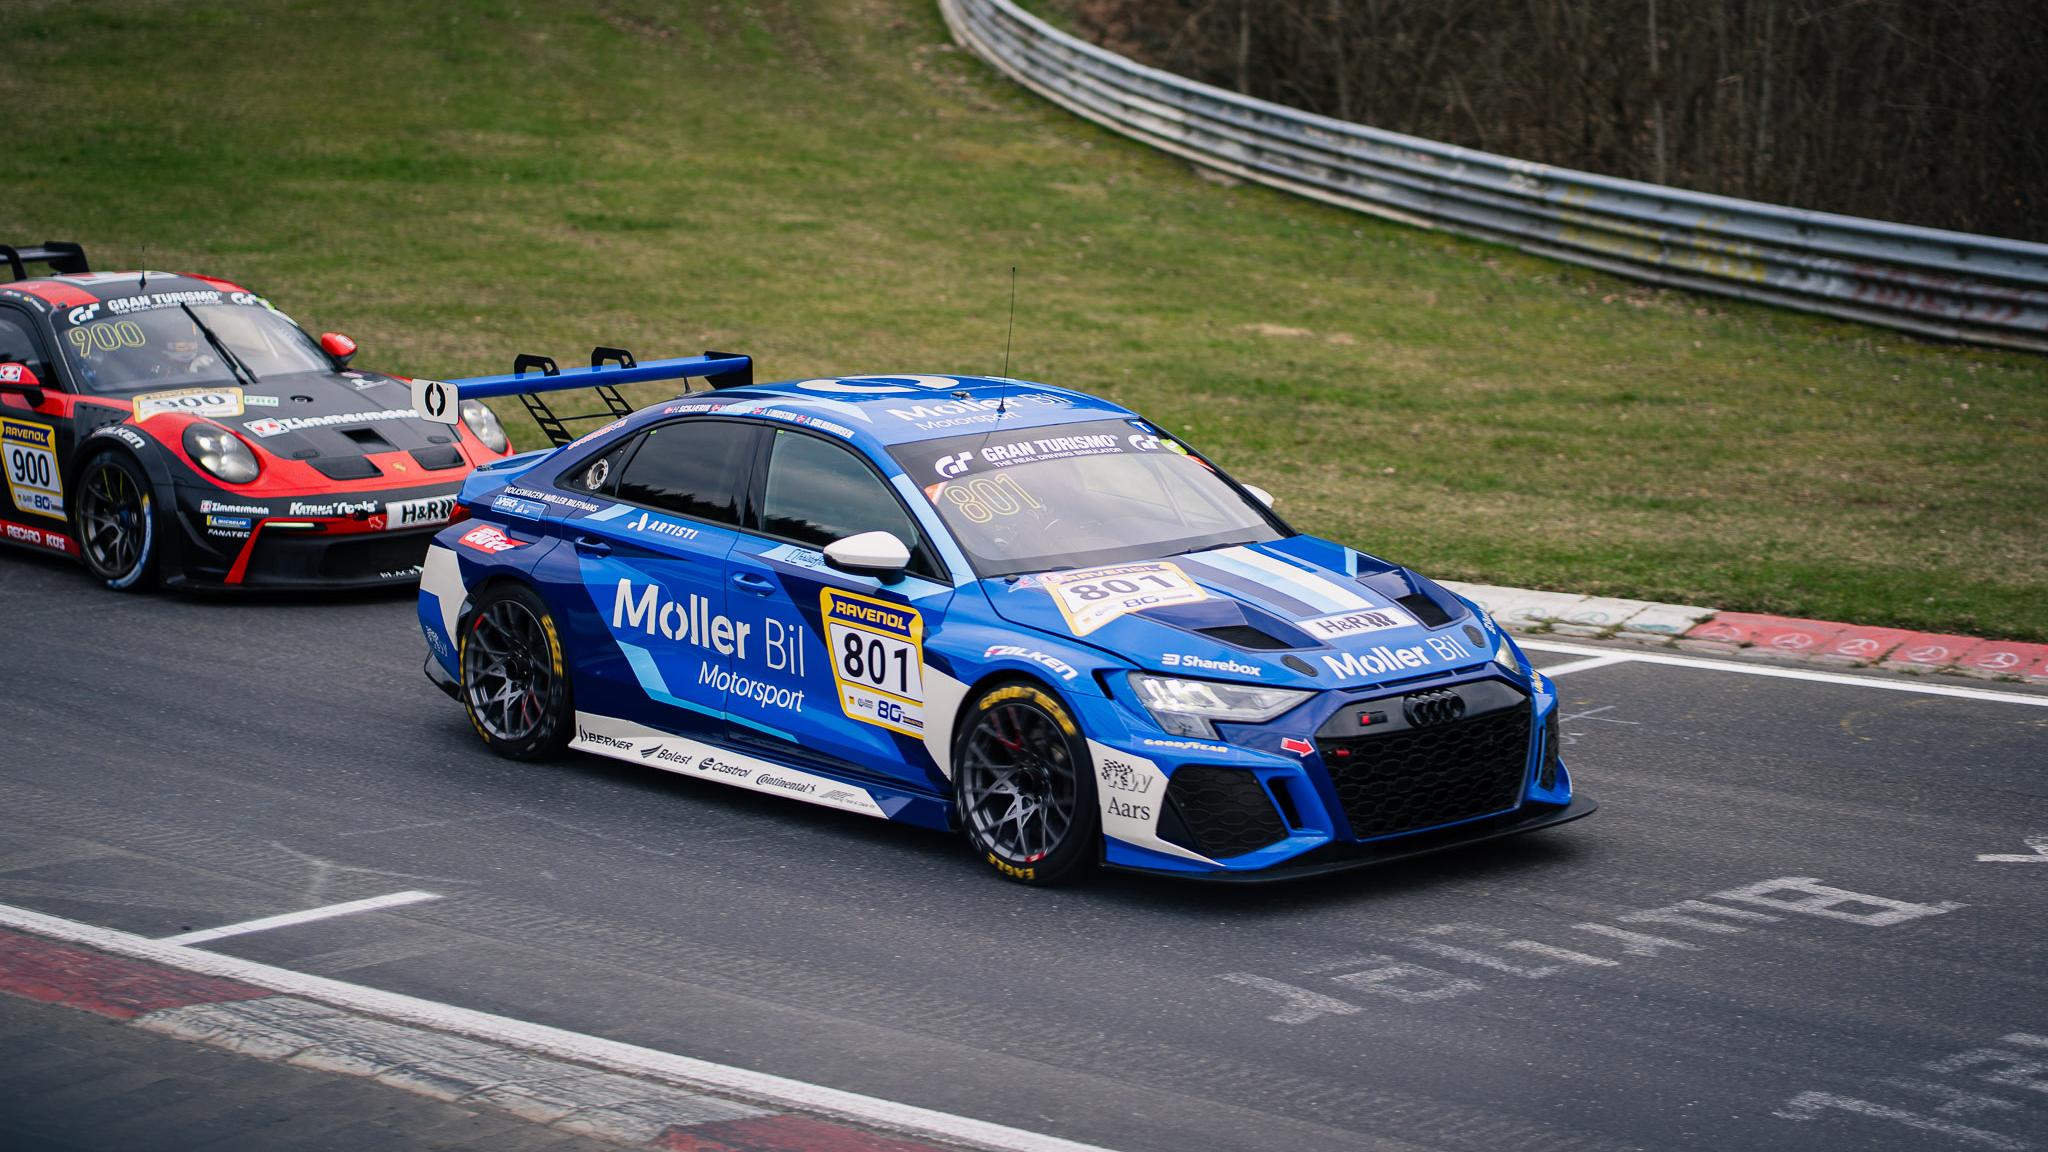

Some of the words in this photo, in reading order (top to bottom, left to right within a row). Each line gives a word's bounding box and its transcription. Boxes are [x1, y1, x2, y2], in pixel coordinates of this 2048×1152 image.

[107, 295, 151, 311] GRAN
[152, 291, 219, 304] TURISMO
[68, 320, 146, 358] 900
[5, 425, 46, 442] RAVENOL
[982, 440, 1037, 462] GRAN
[1034, 434, 1116, 453] TURISMO
[992, 460, 1014, 468] THE
[1014, 456, 1038, 465] REAL
[1038, 451, 1073, 461] DRIVING
[1073, 447, 1123, 456] SIMULATOR
[13, 449, 50, 487] 900
[504, 486, 543, 500] VOLKSWAGEN
[944, 472, 1042, 523] 801
[211, 502, 269, 515] Zimmermann
[402, 501, 439, 524] H&R
[7, 525, 41, 543] RECARO
[207, 528, 251, 538] FANATEC
[648, 520, 699, 540] ARTISTI
[1070, 575, 1175, 600] 801
[835, 600, 908, 631] RAVENOL
[1316, 615, 1366, 634] H&R
[765, 617, 805, 677] Bil
[1425, 634, 1471, 661] Bil
[843, 632, 908, 693] 801
[984, 645, 1079, 680] FALKEN
[1182, 655, 1261, 677] Sharebox
[699, 661, 805, 713] Motorsport
[1143, 739, 1228, 753] GOODYEAR
[588, 732, 633, 750] BERNER
[657, 749, 692, 765] Bolest
[712, 761, 752, 778] Castrol
[756, 773, 810, 793] Continental
[1107, 796, 1150, 821] Aars
